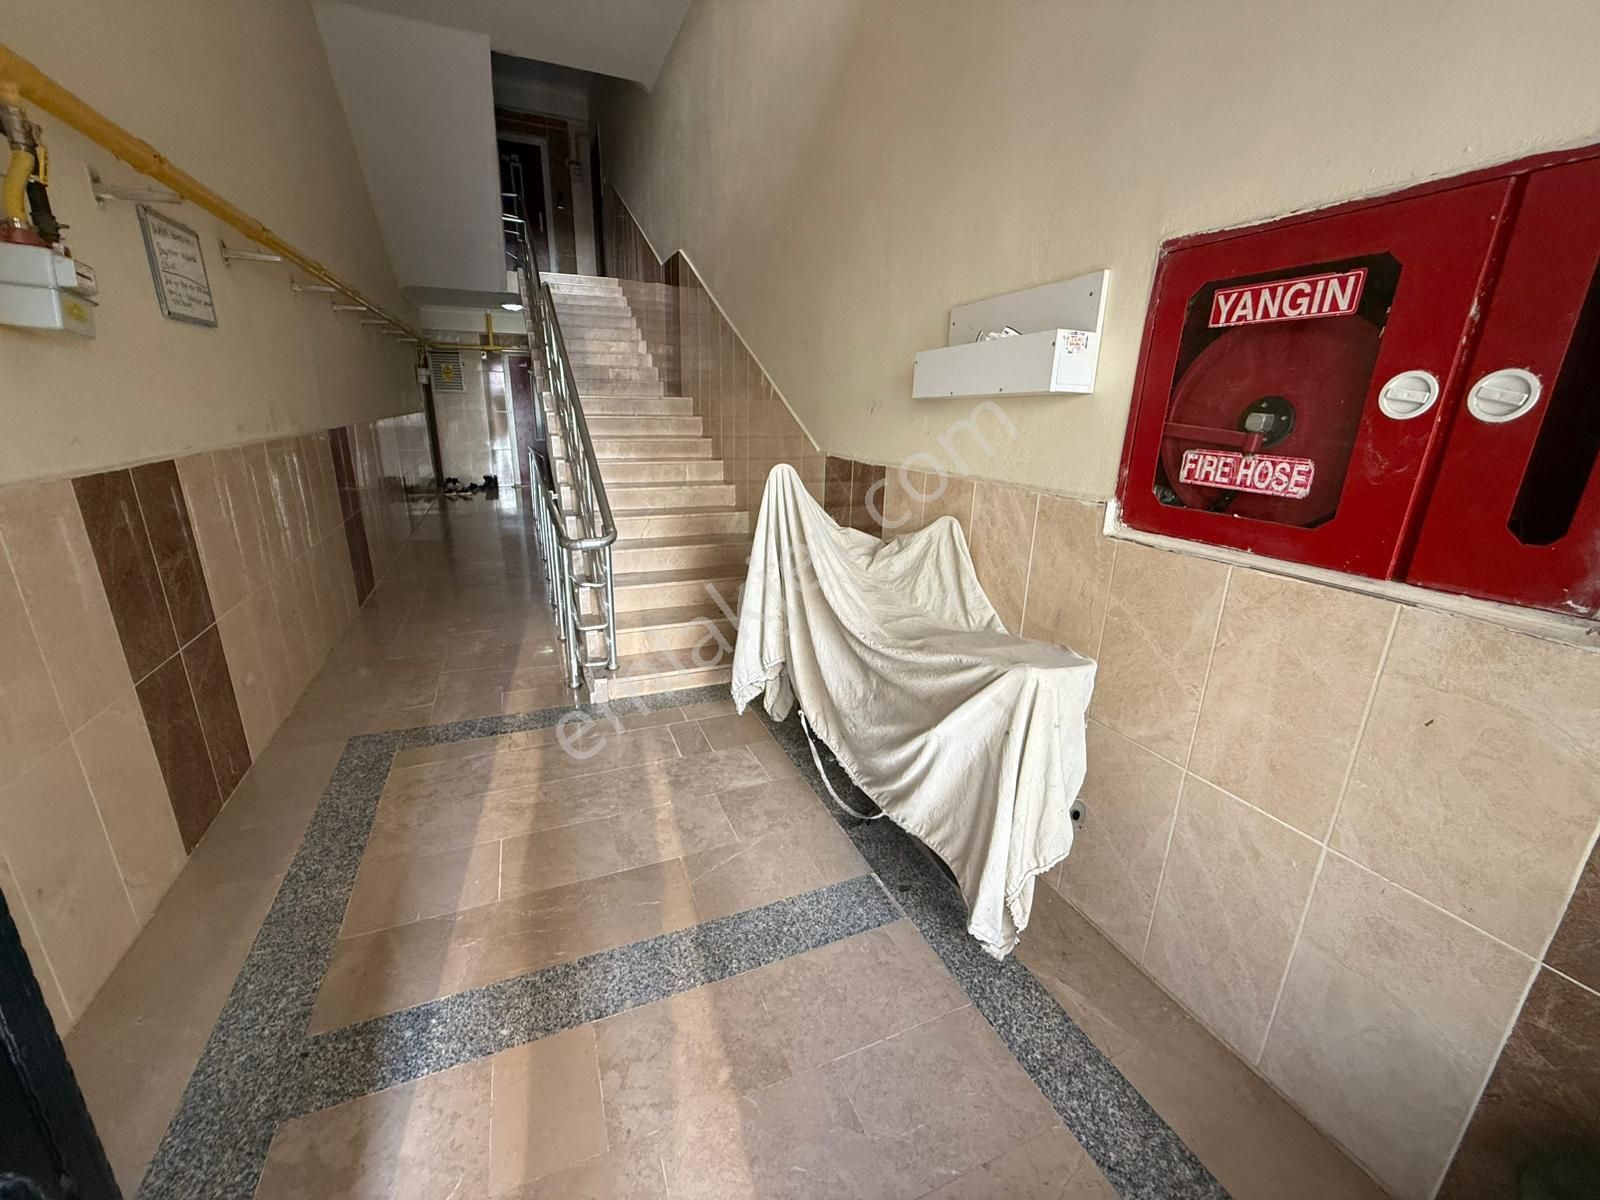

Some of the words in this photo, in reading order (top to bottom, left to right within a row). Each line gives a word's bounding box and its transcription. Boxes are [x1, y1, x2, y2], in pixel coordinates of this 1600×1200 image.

[1216, 276, 1356, 324] YANGIN
[1183, 453, 1232, 484] FIRE
[1237, 457, 1311, 493] HOSE
